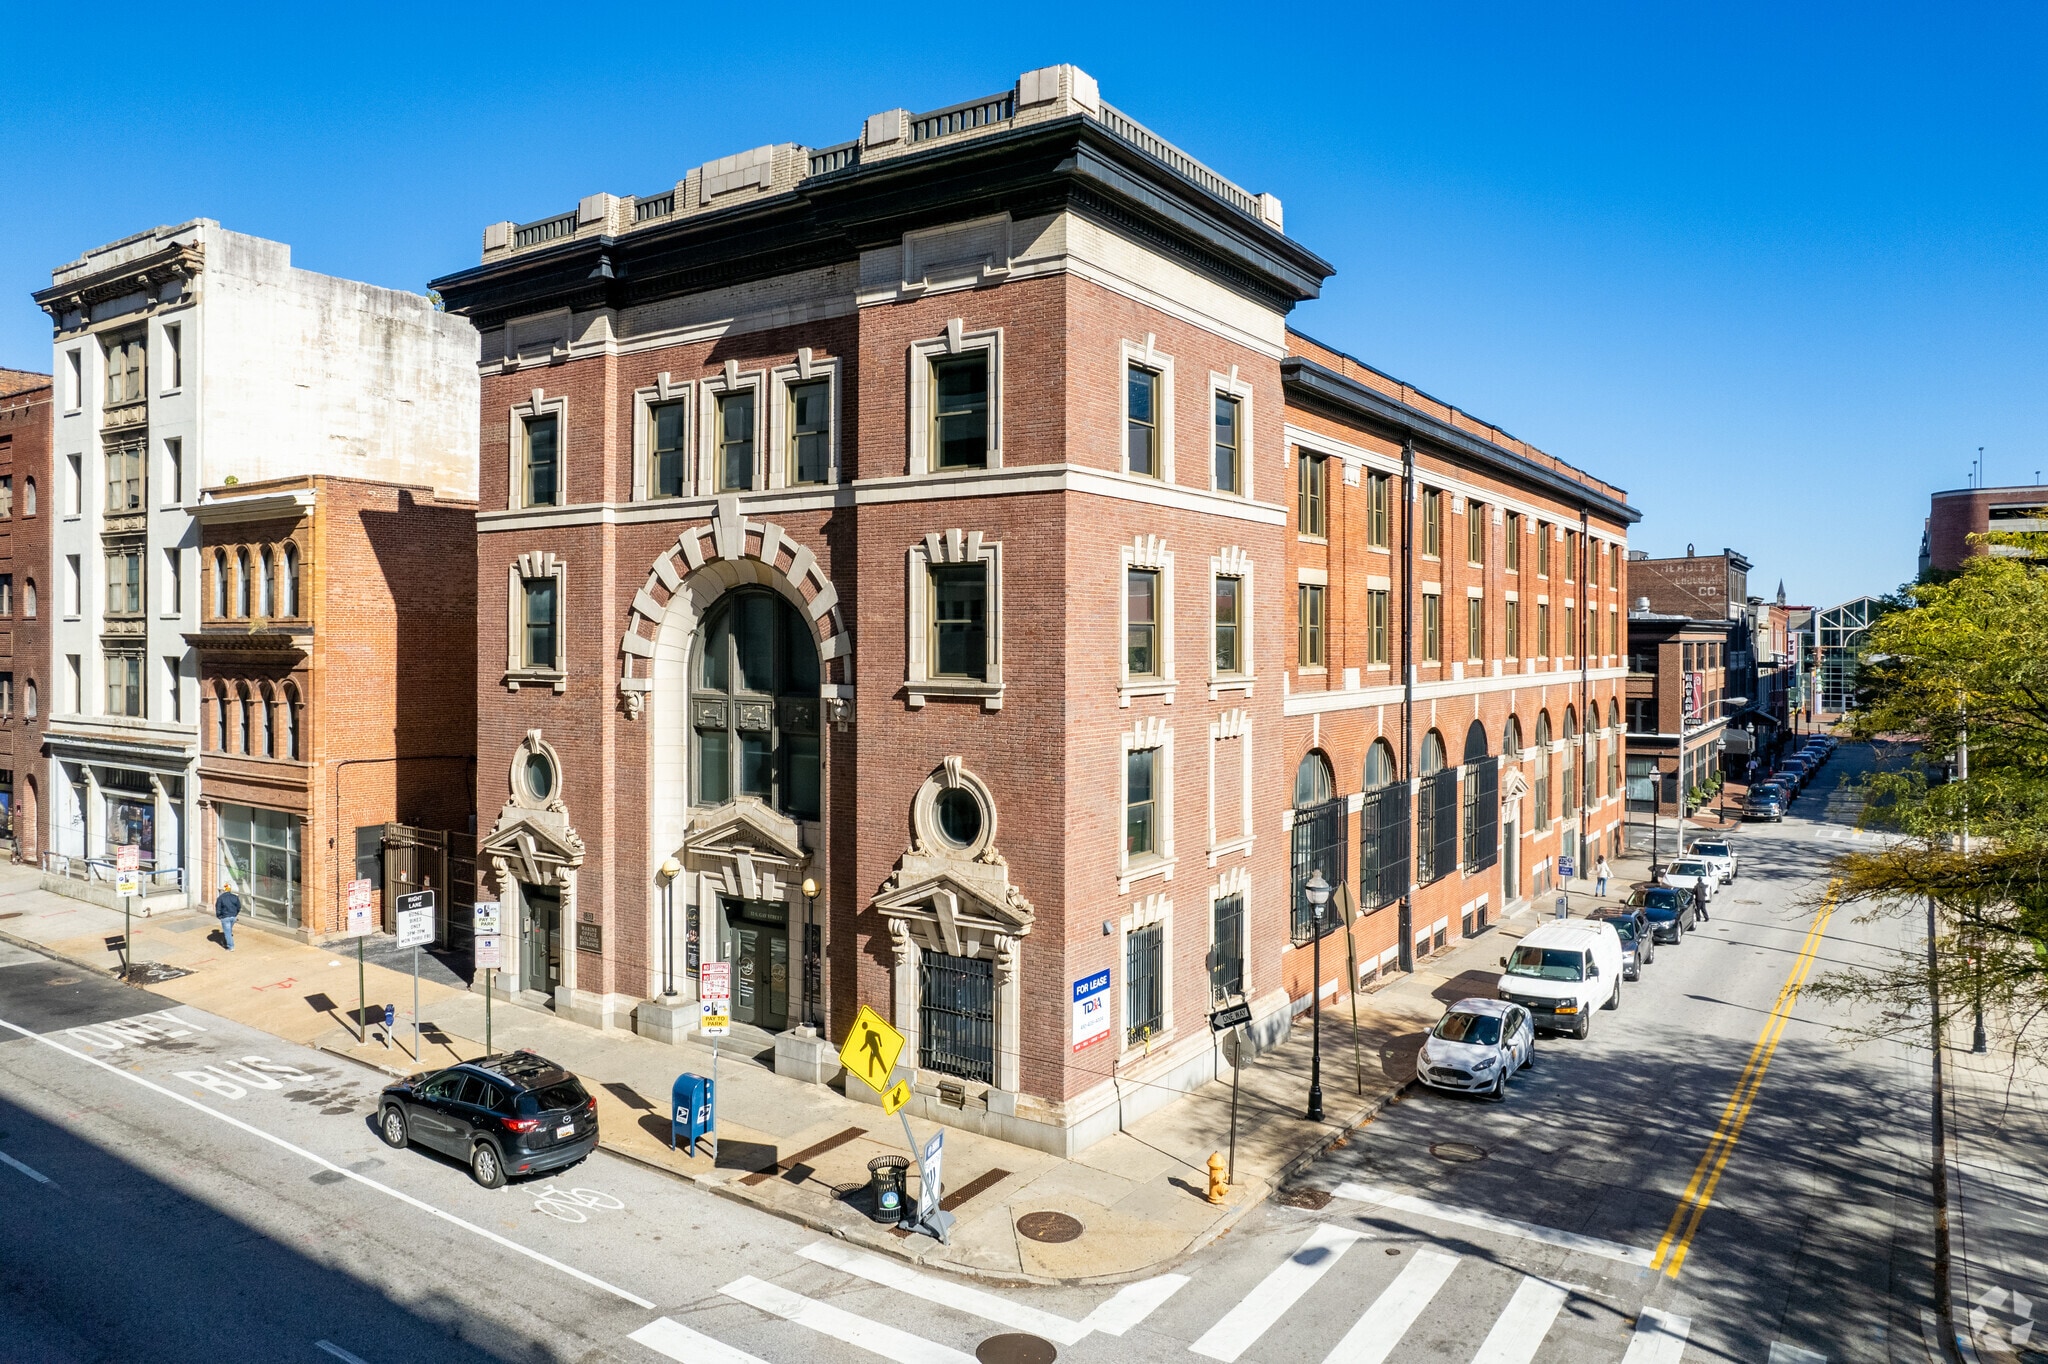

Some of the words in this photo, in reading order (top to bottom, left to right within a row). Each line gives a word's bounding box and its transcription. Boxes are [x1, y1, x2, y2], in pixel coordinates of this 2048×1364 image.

[1698, 586, 1720, 596] CO.
[1685, 673, 1693, 718] HAVANA
[1076, 982, 1088, 996] FOR
[1090, 975, 1108, 990] LEASE
[65, 1010, 208, 1049] ONLY
[1222, 1013, 1235, 1022] ONE
[1235, 1008, 1246, 1019] WAY
[173, 1056, 314, 1100] BUS
